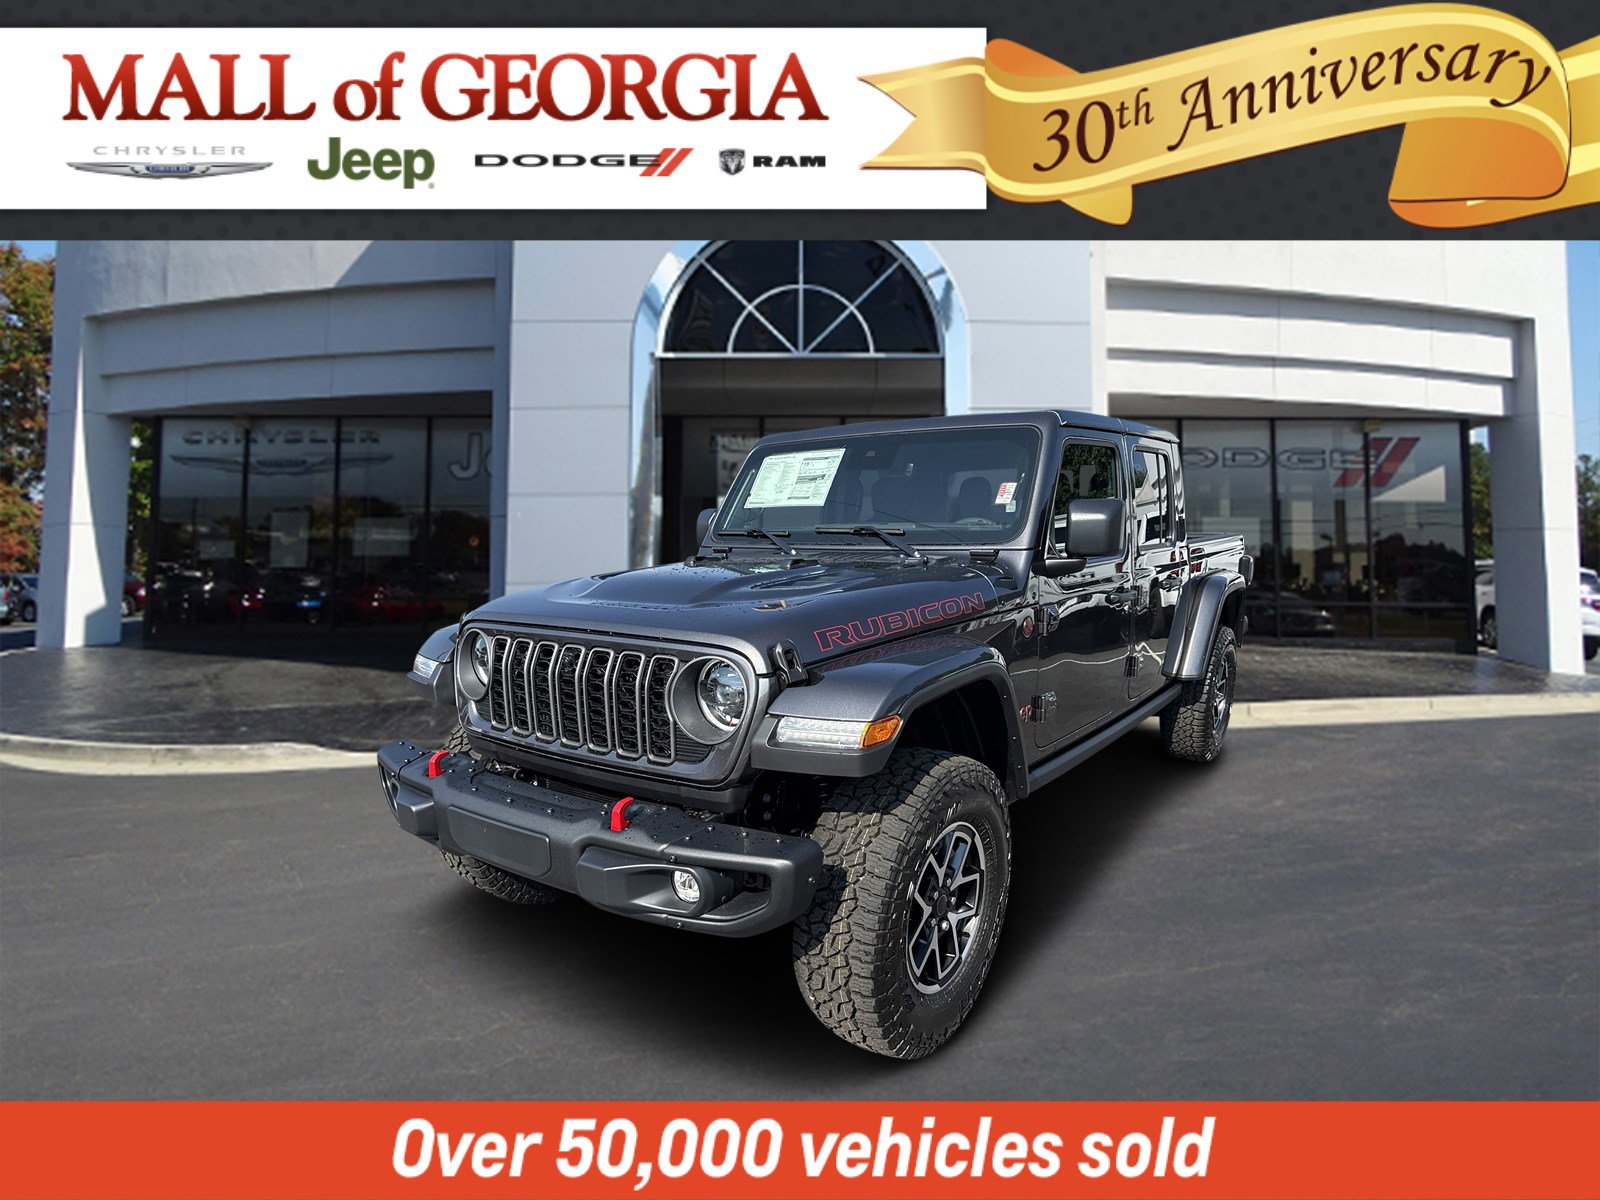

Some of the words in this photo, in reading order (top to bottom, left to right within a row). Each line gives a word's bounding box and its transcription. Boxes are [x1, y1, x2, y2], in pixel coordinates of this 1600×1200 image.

[183, 430, 381, 445] CHRYSLER
[1182, 448, 1376, 471] ODGE
[814, 591, 986, 651] RUBICON
